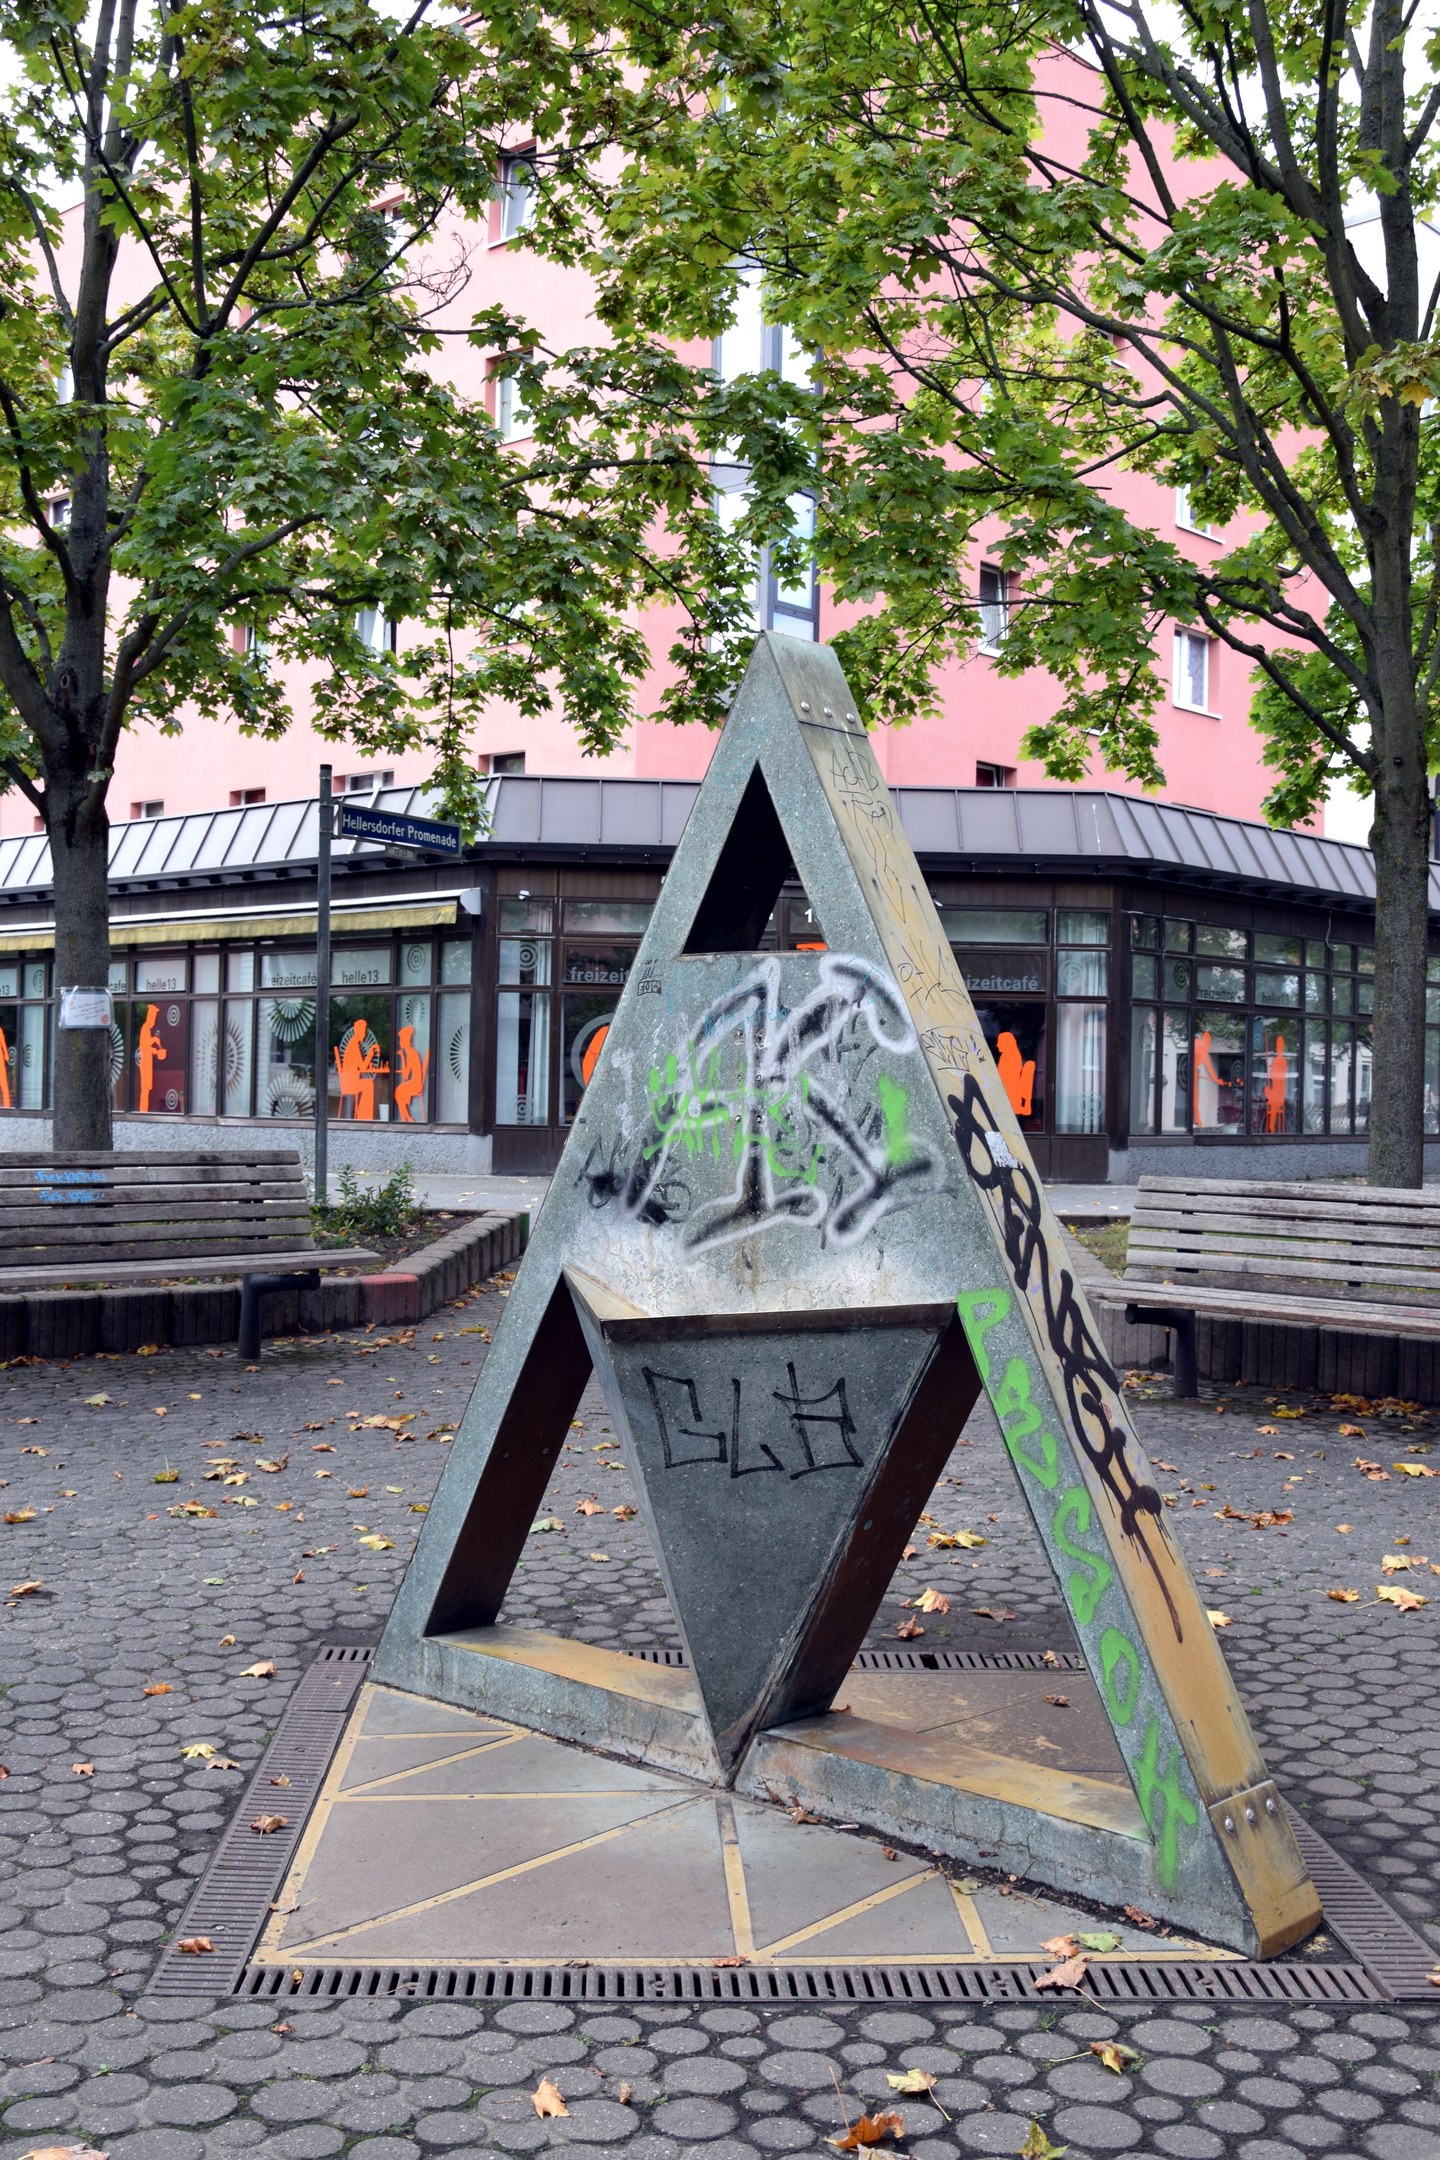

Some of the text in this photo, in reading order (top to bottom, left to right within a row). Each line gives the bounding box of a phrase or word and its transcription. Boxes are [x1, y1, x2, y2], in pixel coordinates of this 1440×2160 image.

[342, 813, 457, 848] Hellersdorfer Promenade
[342, 969, 379, 984] helle13
[966, 974, 1039, 990] izeitcafé
[146, 978, 177, 991] helle13
